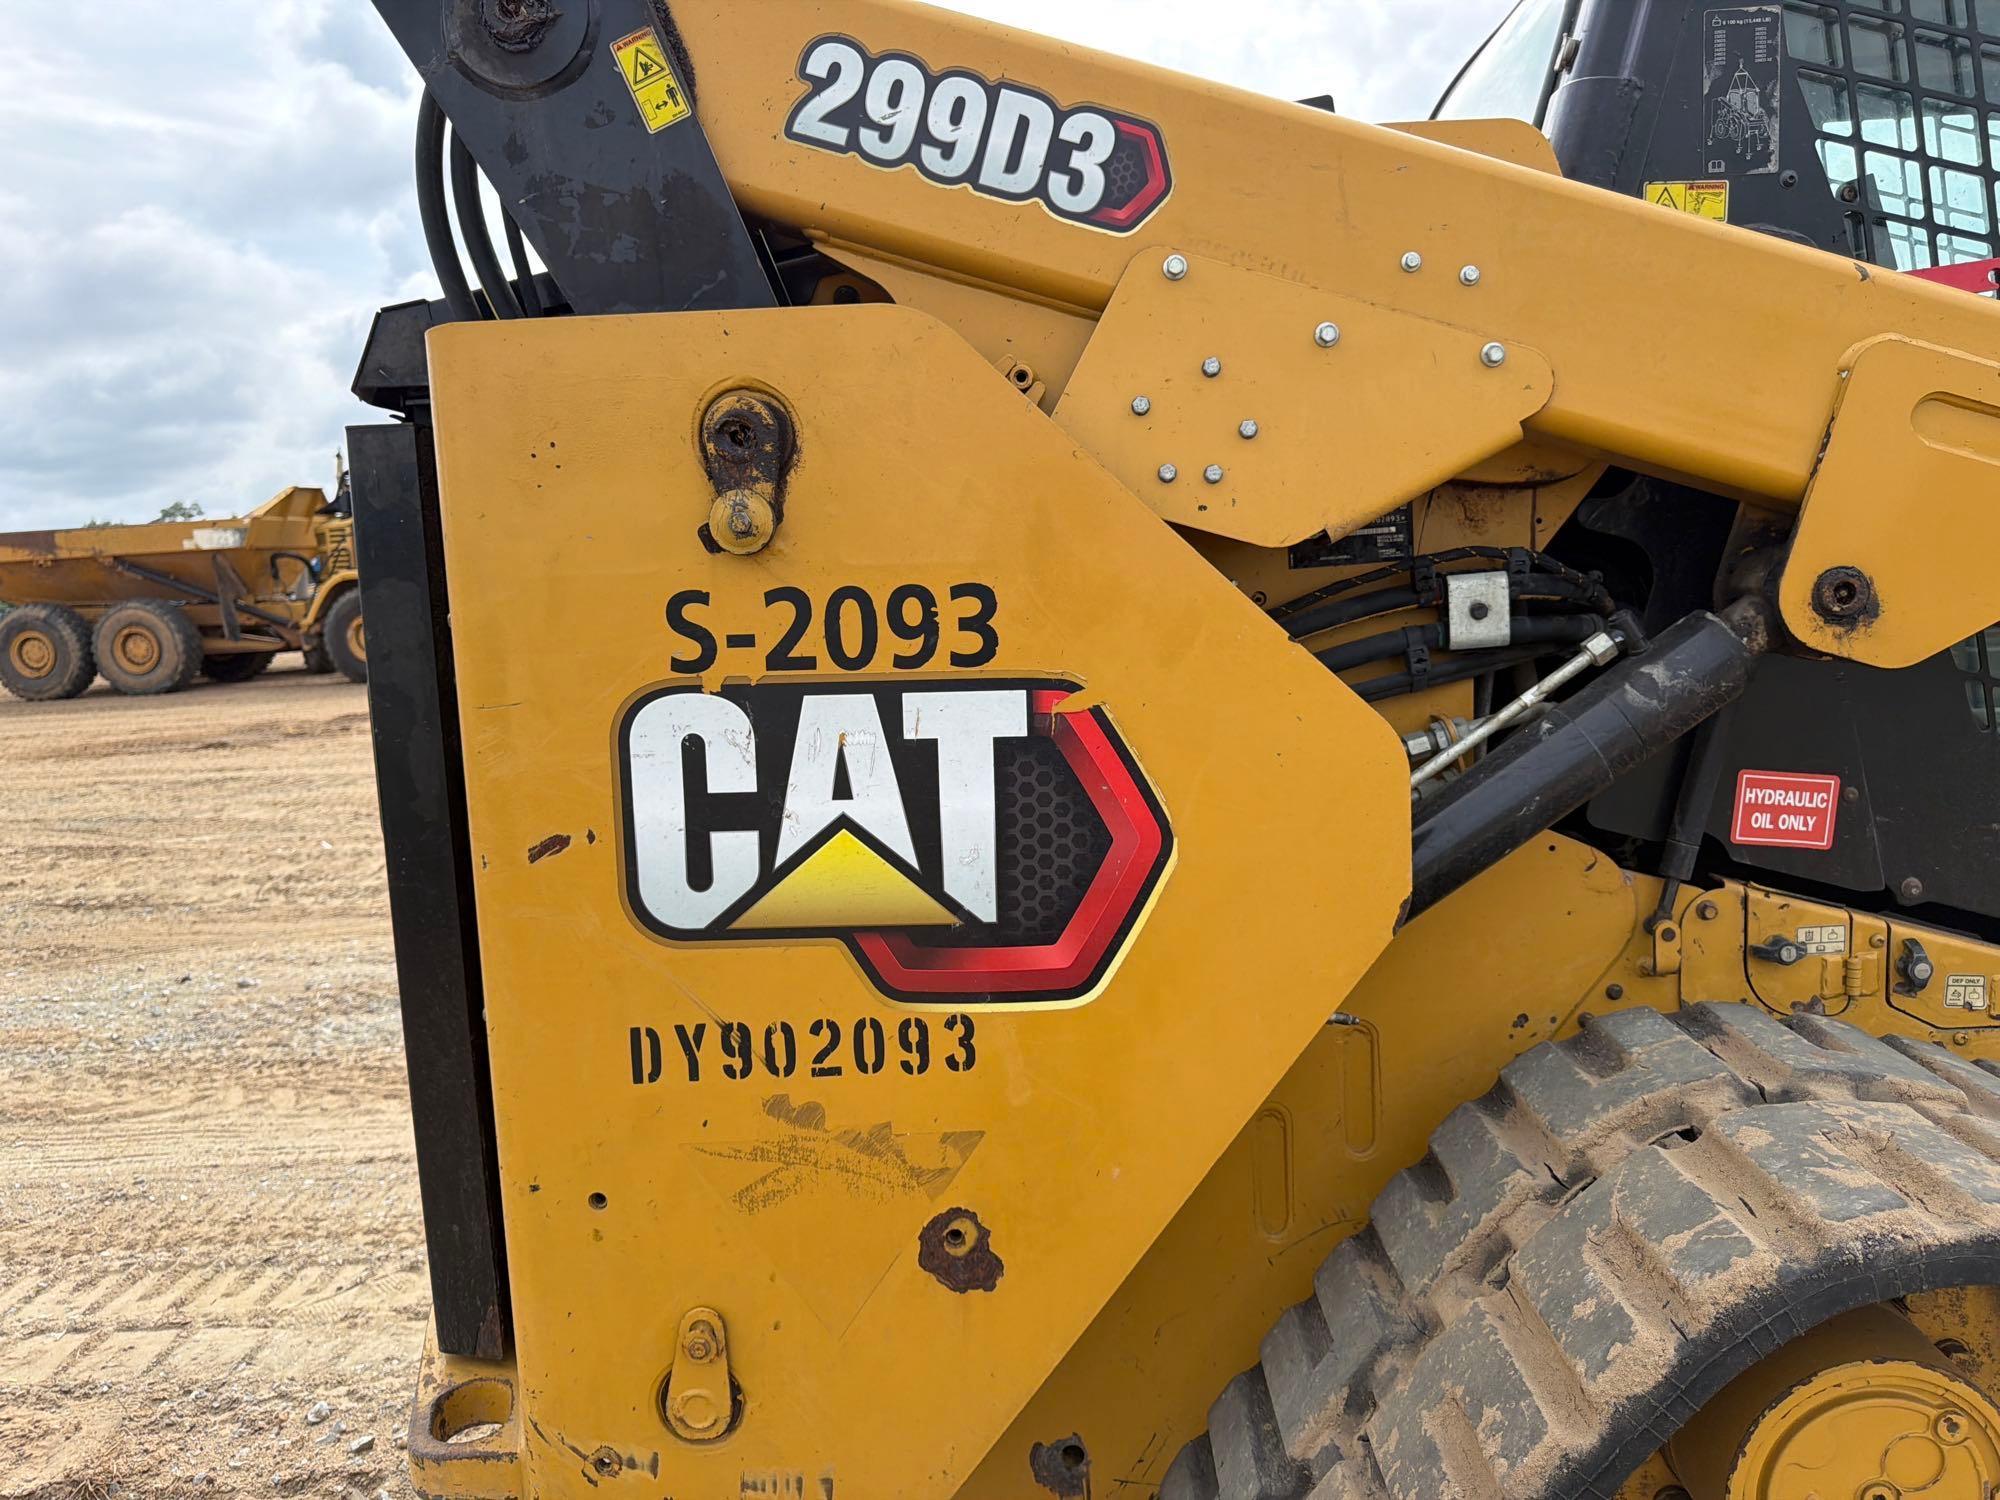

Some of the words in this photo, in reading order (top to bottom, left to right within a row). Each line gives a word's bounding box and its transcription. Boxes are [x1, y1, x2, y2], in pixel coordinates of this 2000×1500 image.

[622, 30, 651, 47] WARNING
[792, 42, 1116, 213] 299D3
[665, 582, 999, 674] S-2093
[629, 690, 1028, 930] CAT
[1745, 788, 1828, 808] HYDRAULIC
[1751, 812, 1774, 829] OIL
[1778, 814, 1817, 832] ONLY
[629, 1013, 977, 1084] DY902093
